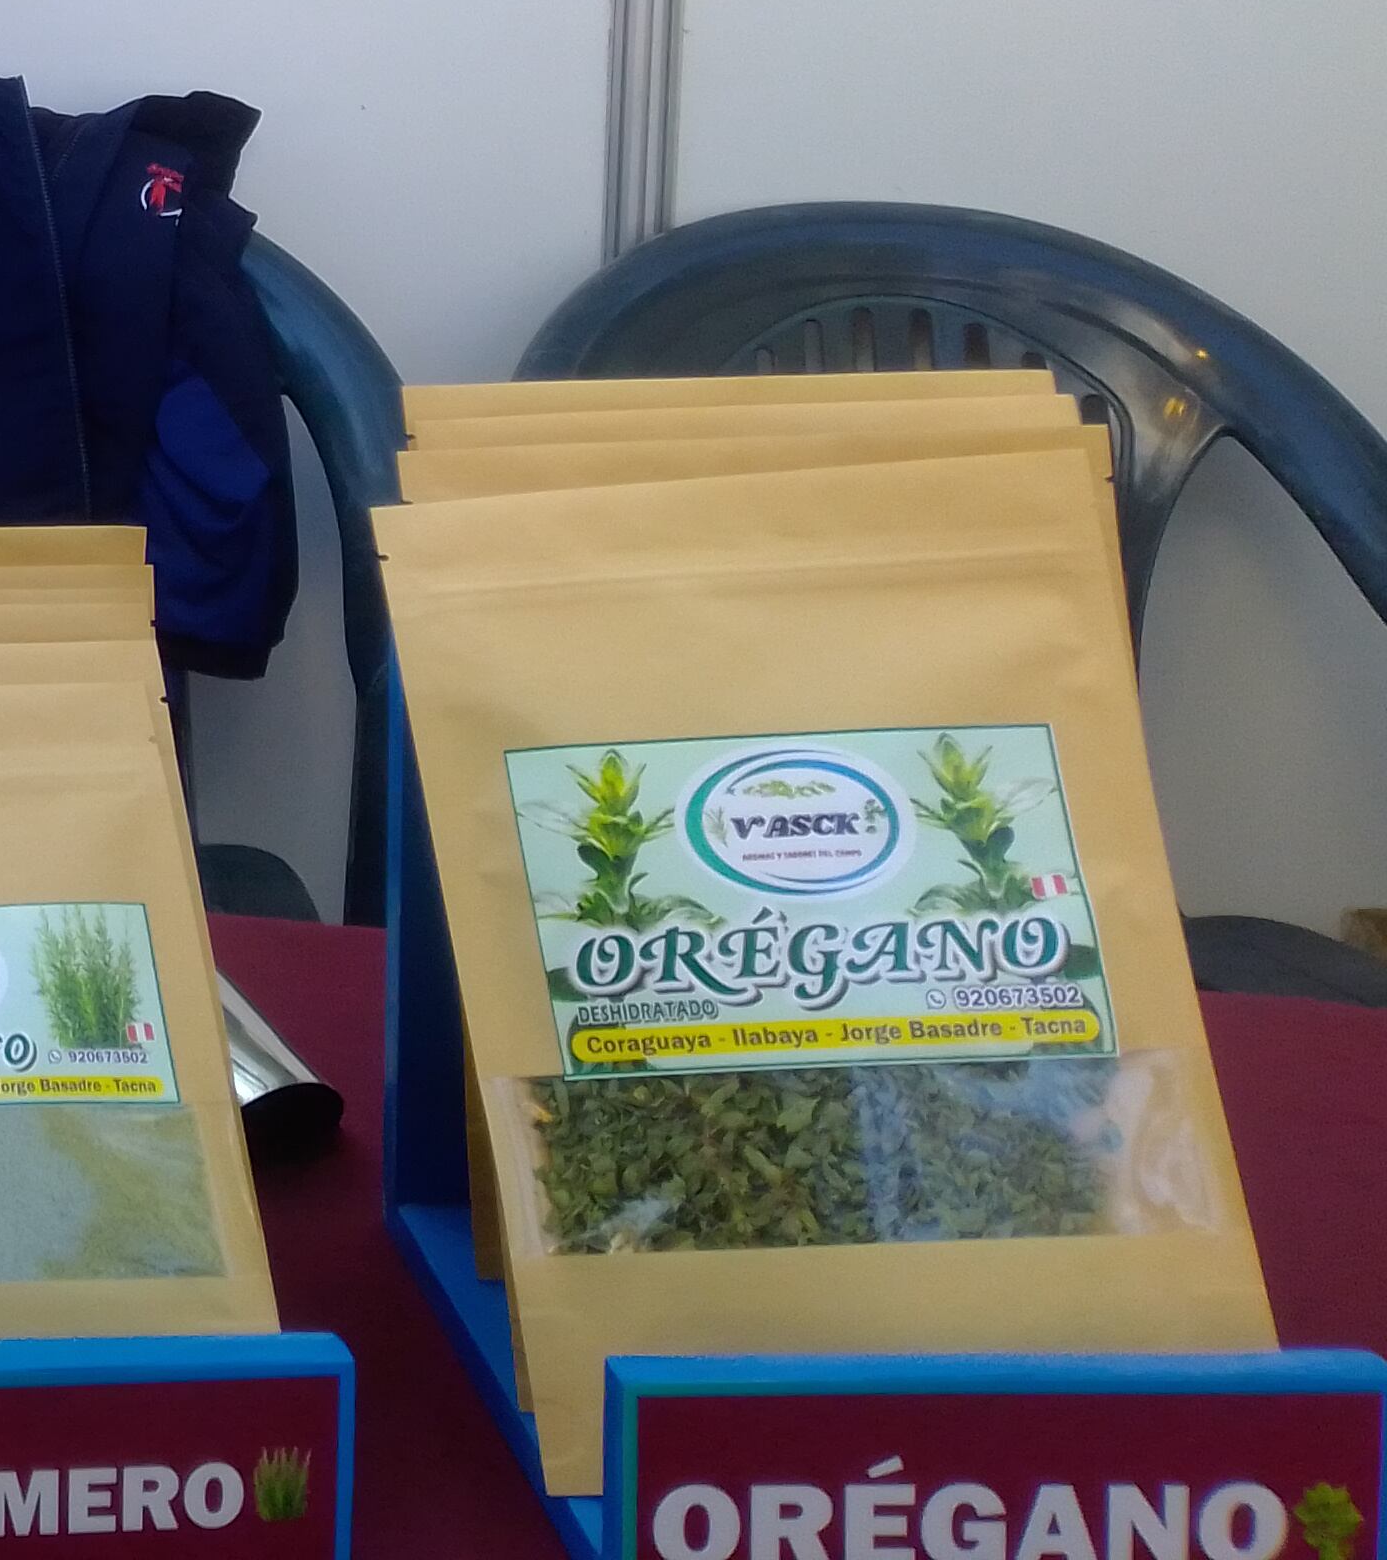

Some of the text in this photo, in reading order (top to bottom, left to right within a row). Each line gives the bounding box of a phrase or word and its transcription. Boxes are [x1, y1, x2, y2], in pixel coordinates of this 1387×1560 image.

[574, 906, 1070, 1012] ORÉGANO
[954, 985, 1082, 1008] 920673502
[577, 998, 719, 1025] DESHIDRATADO
[587, 1015, 1087, 1058] Coraguaya Ilabaya Jorge Basadre Tacna
[67, 1050, 149, 1065] 920673502
[41, 1078, 102, 1093] Basadre
[113, 1079, 157, 1093] Tacna
[652, 1455, 1288, 1560] ORÉGANO
